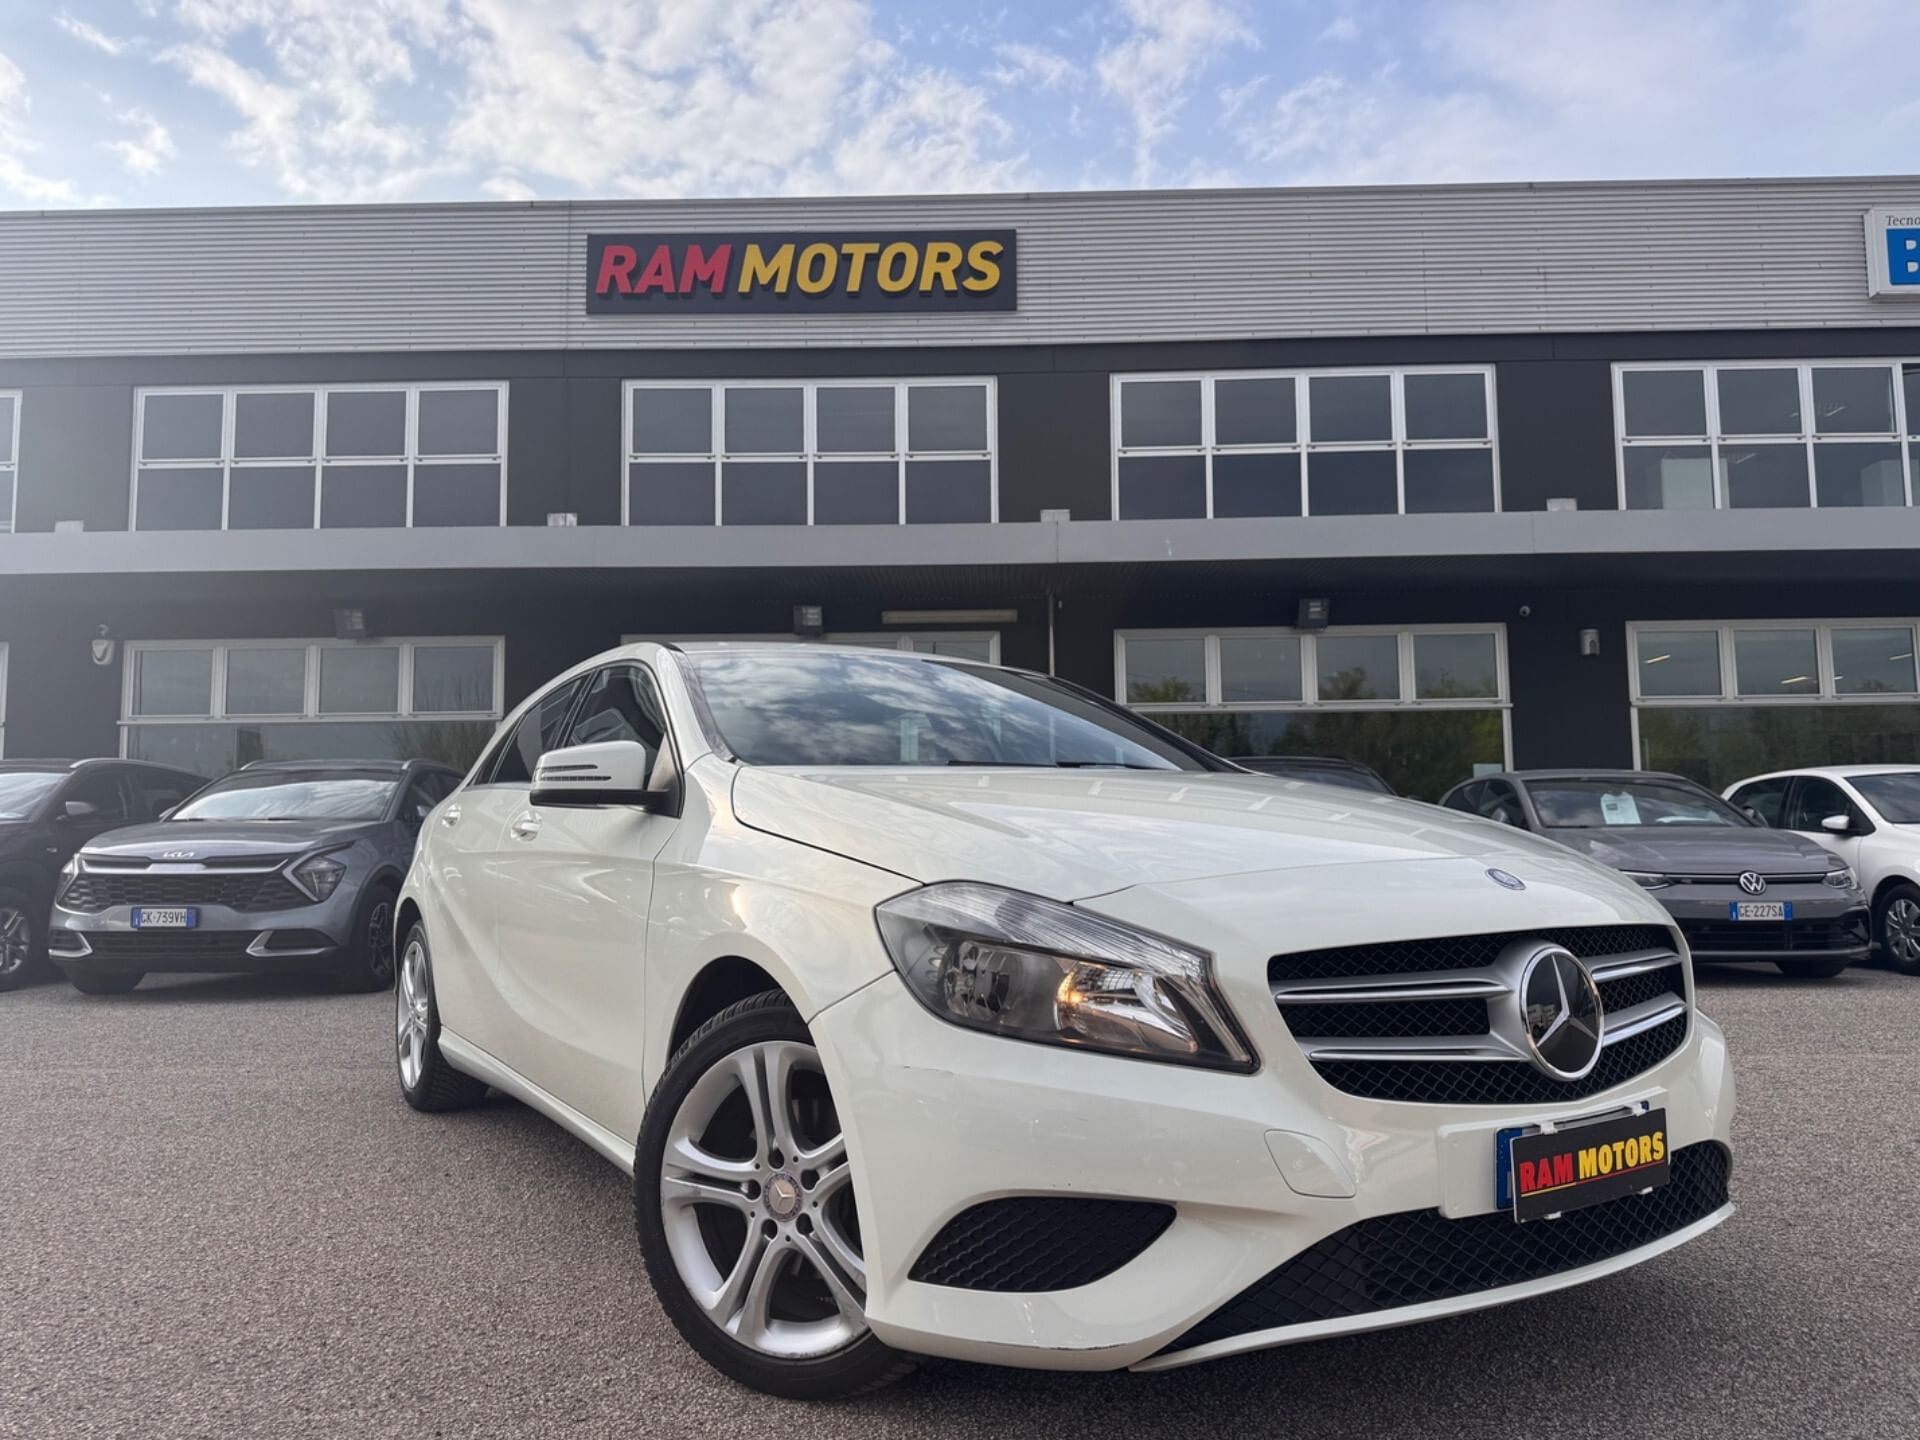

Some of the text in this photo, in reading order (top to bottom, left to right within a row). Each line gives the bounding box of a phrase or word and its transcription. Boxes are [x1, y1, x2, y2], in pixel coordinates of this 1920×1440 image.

[596, 240, 1004, 294] RAM MOTORS
[1519, 1131, 1664, 1193] RAM MOTORS
